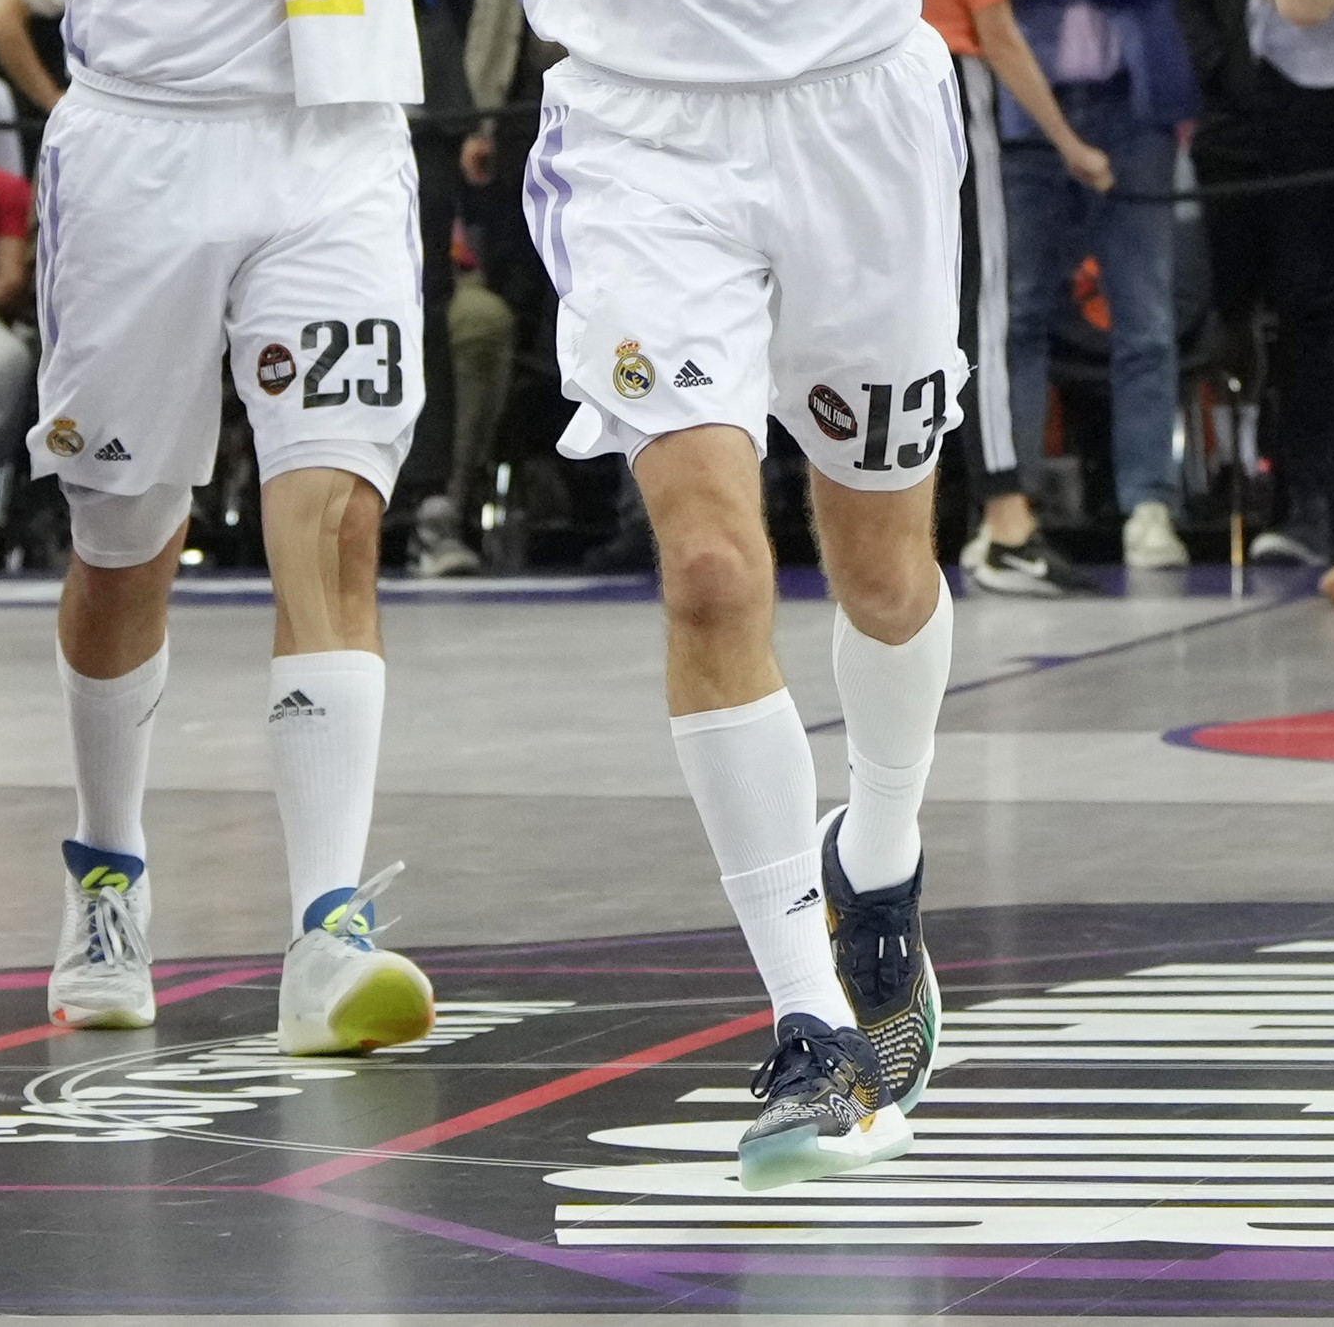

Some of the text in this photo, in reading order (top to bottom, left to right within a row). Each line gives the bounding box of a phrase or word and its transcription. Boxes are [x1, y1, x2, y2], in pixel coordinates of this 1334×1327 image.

[301, 318, 403, 410] 23
[673, 376, 713, 388] adidas
[813, 395, 852, 431] FINAL FOUR
[854, 369, 948, 471] 13
